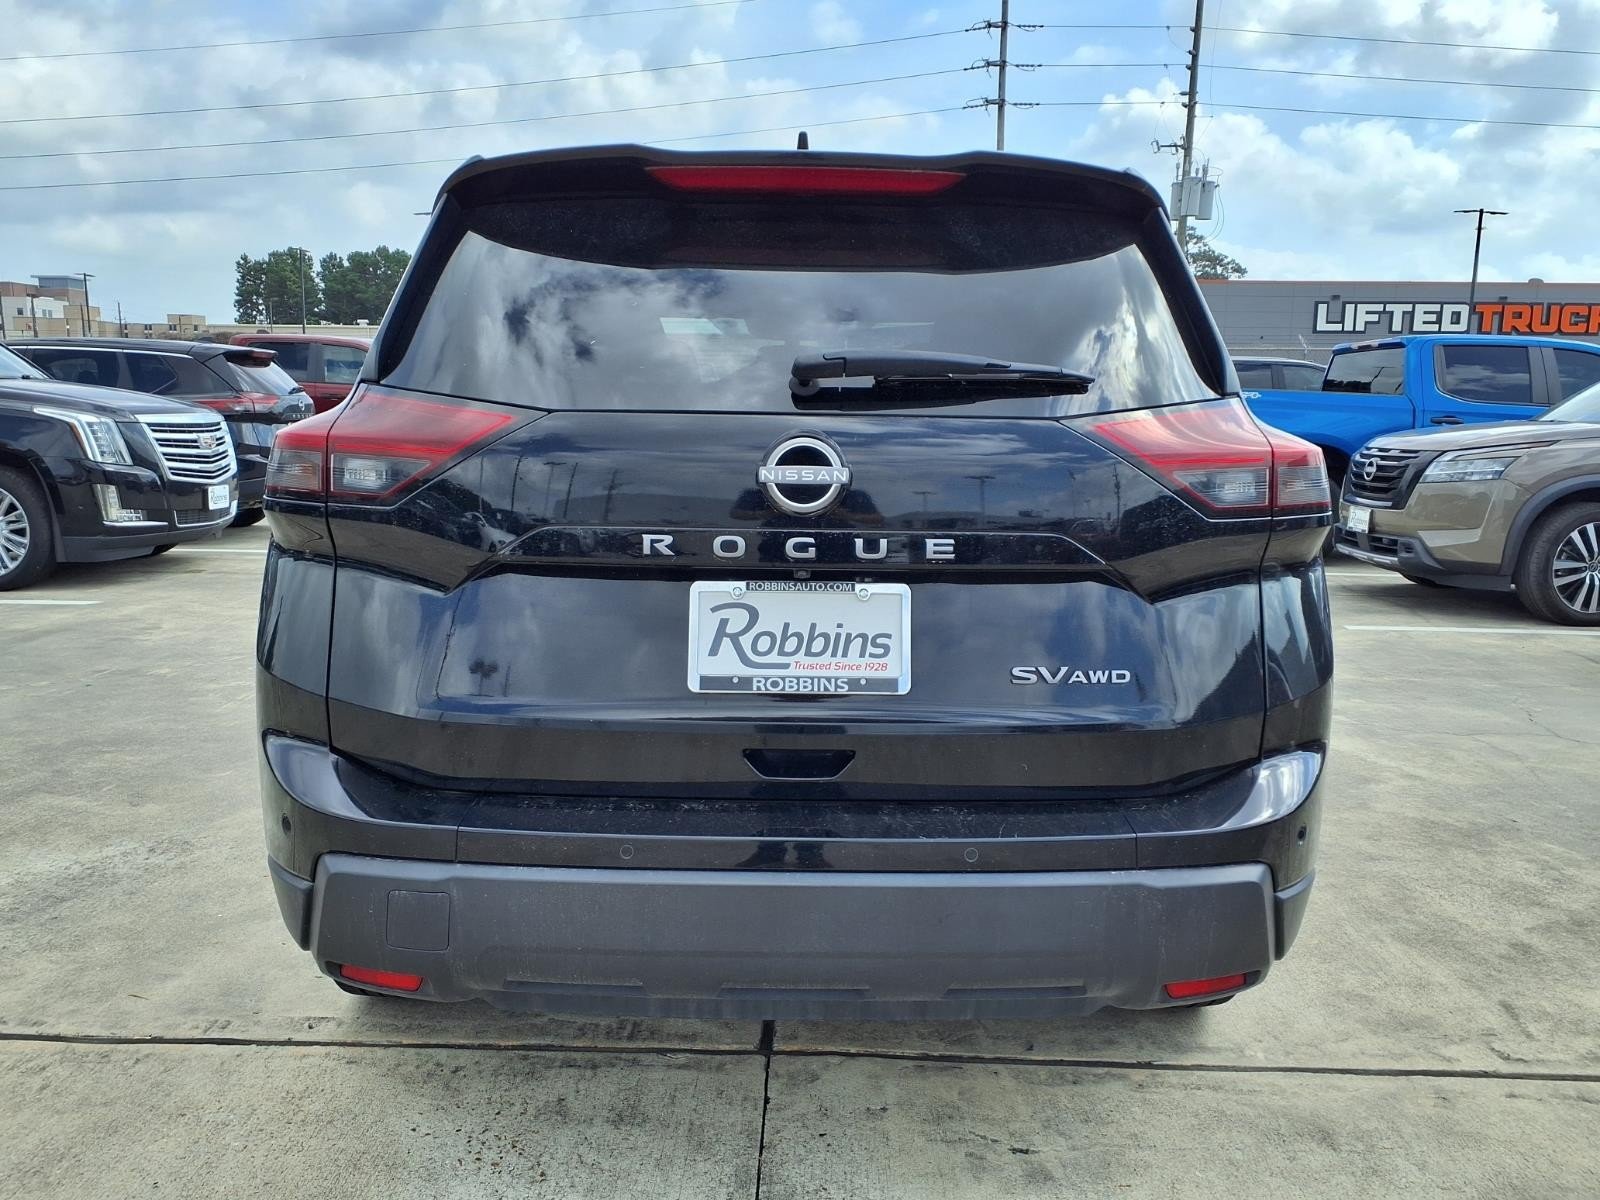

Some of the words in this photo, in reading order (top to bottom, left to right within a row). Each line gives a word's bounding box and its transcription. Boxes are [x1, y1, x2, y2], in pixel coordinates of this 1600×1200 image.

[1316, 303, 1470, 332] LIFTED
[759, 469, 847, 481] NISSAN
[641, 534, 956, 560] ROGUE
[749, 582, 853, 592] ROBBINSAUTO.COM
[707, 602, 893, 670] Robbins
[793, 660, 832, 671] Trusted
[834, 662, 862, 672] Since
[864, 662, 888, 672] 1928
[1011, 666, 1069, 684] SV
[1068, 670, 1131, 684] AWD
[752, 677, 849, 692] ROBBINS
